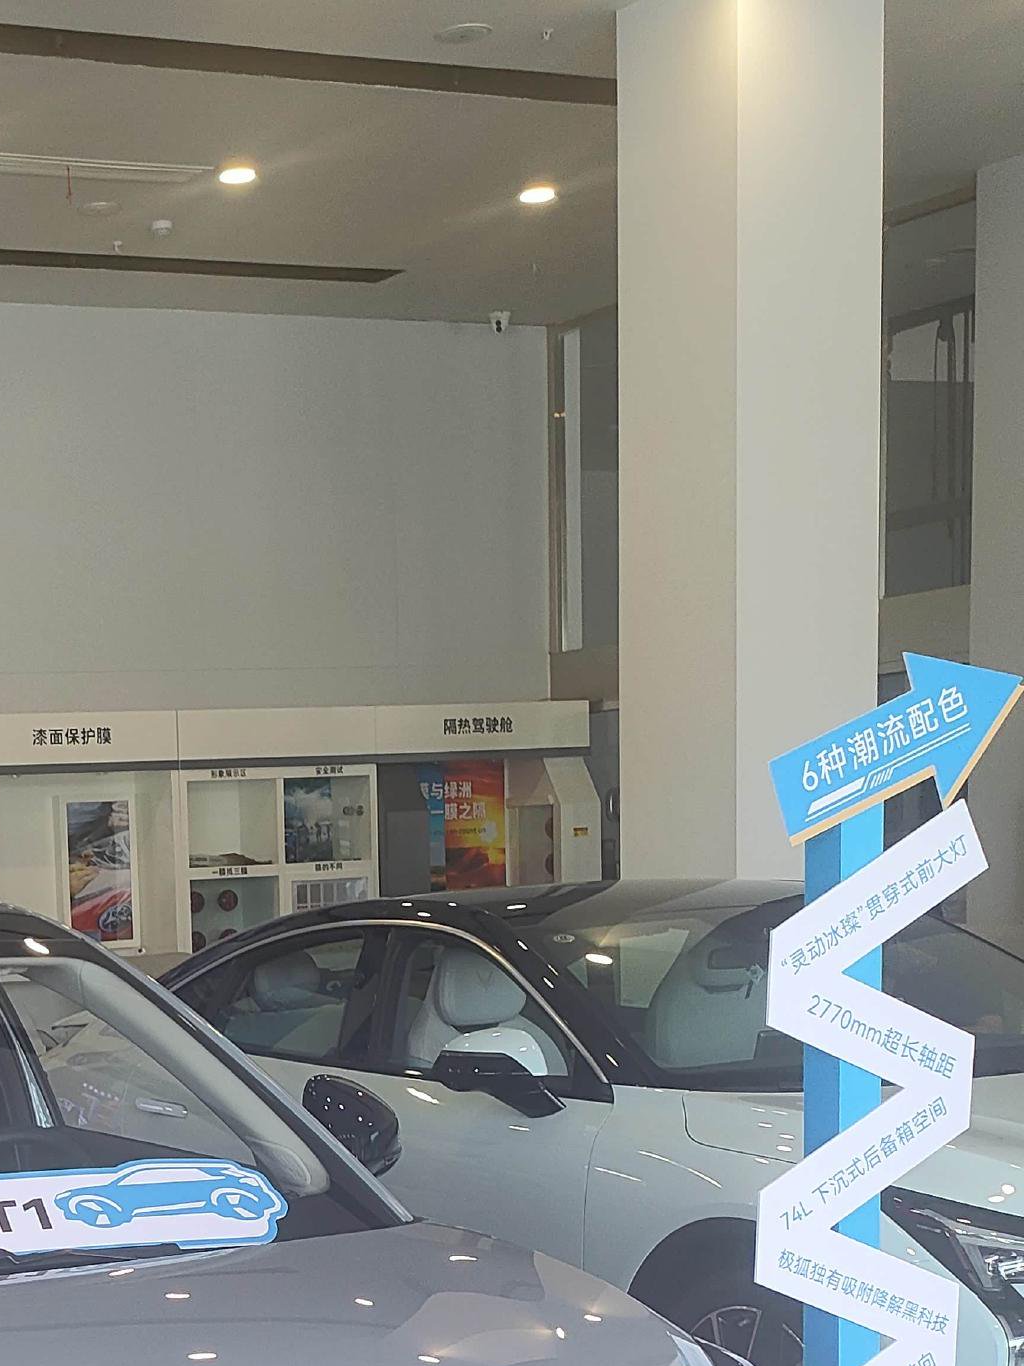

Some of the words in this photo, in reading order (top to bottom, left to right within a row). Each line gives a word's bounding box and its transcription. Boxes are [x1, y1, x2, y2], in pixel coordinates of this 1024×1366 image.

[32, 727, 112, 746] 漆面保护膜
[443, 716, 513, 735] 隔热驾驶舱
[801, 685, 969, 792] 6种潮流配色
[780, 834, 968, 975] “灵动冰璨”贯穿式前大灯
[806, 994, 957, 1079] 2770mm超长轴距
[779, 1201, 814, 1231] 74L
[812, 1096, 948, 1204] 下沉式后备箱空间
[778, 1248, 950, 1335] 极狐独有吸附降解黑科技
